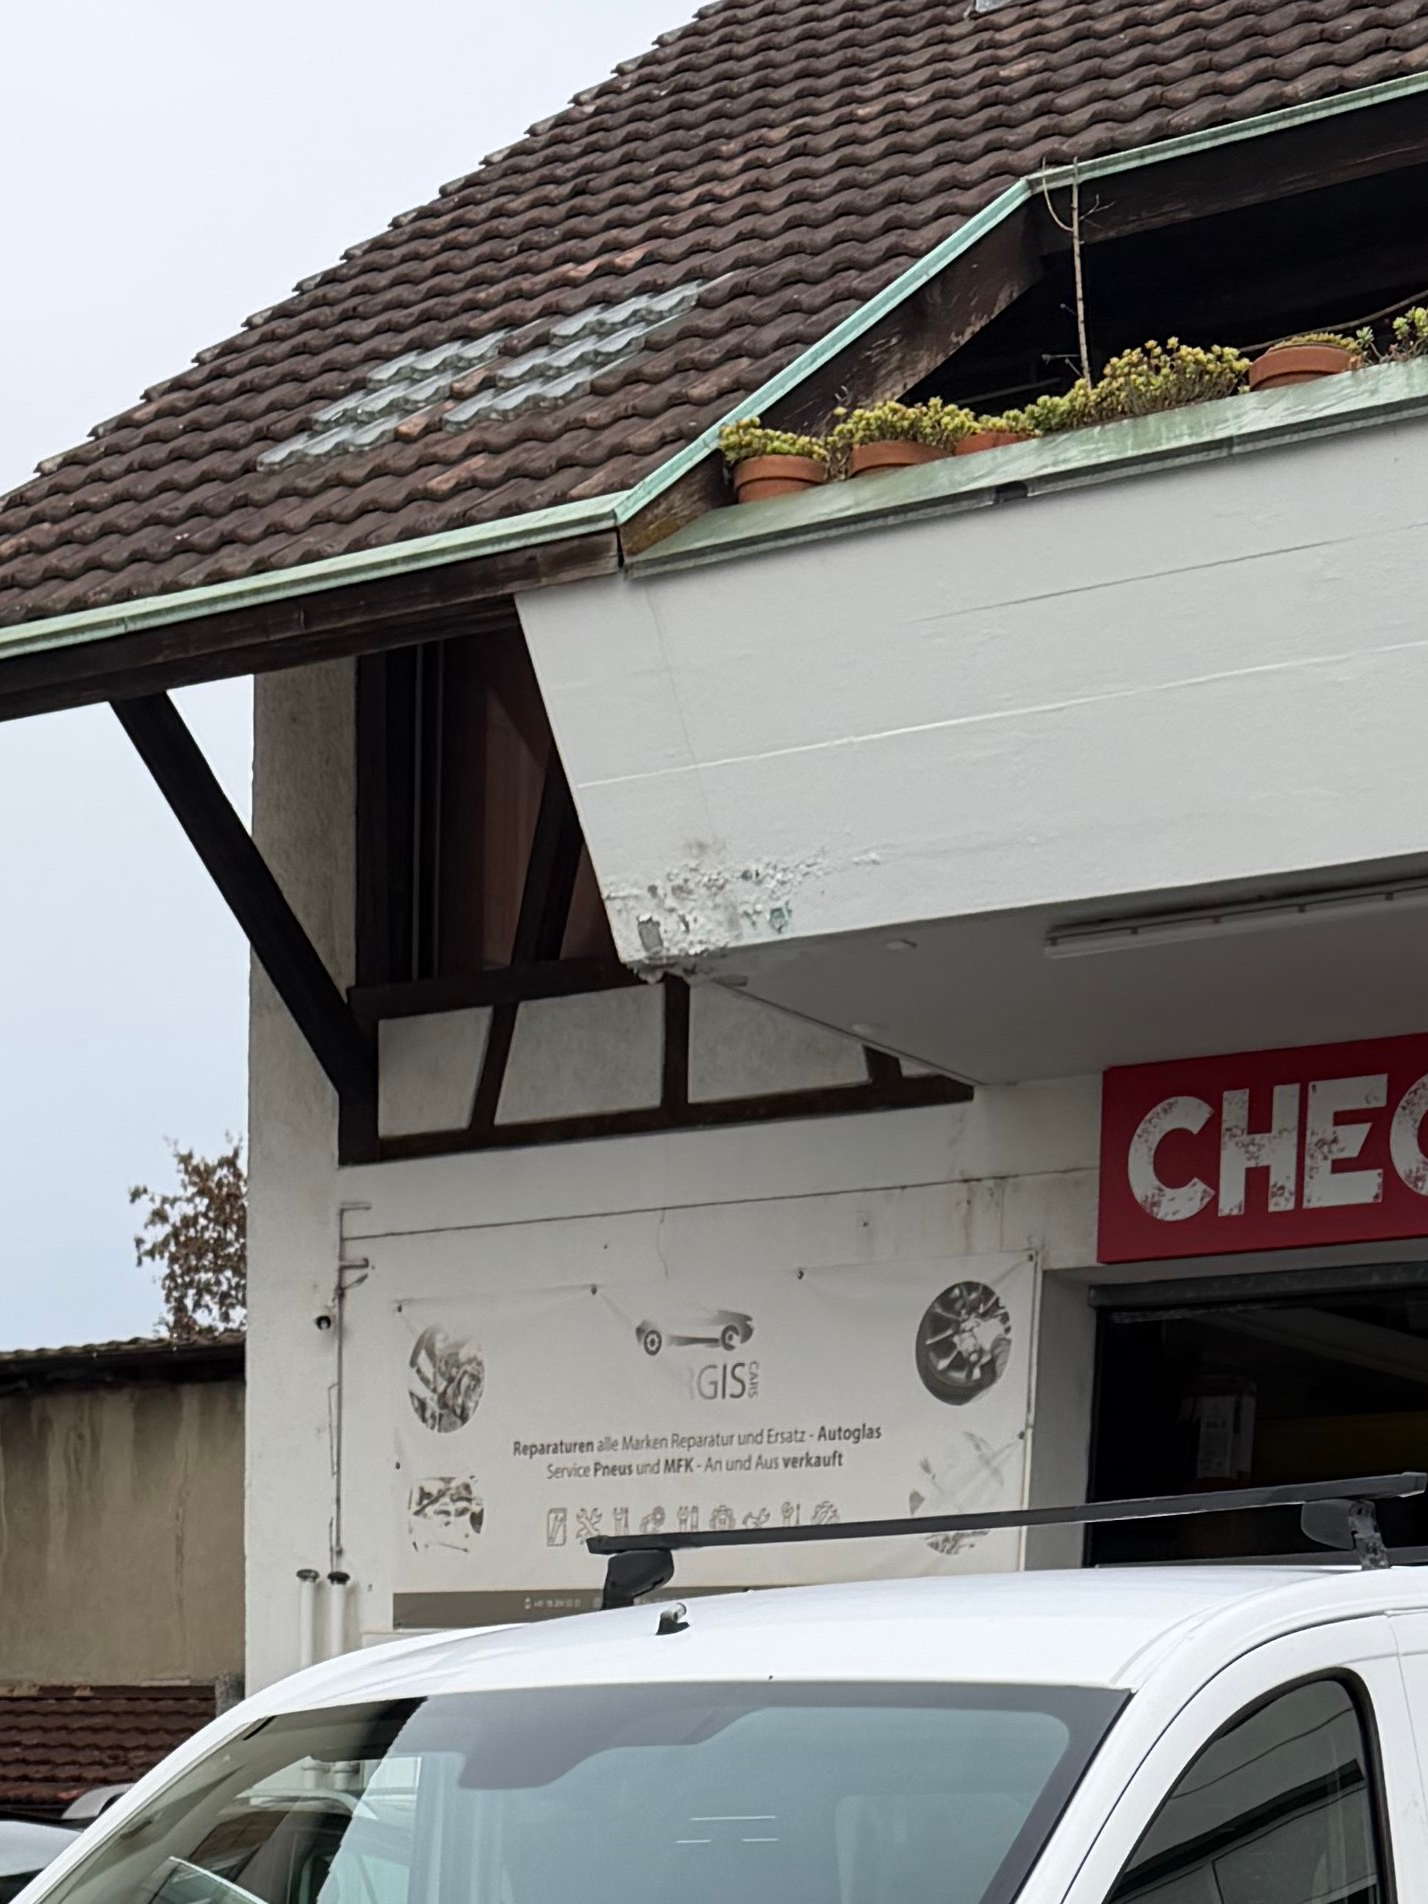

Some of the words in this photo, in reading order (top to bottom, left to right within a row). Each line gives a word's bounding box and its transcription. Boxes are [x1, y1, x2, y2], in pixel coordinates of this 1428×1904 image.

[694, 1362, 746, 1400] GIS
[513, 1440, 594, 1459] Reparaturen
[597, 1436, 619, 1452] alle
[622, 1434, 668, 1451] Marken
[671, 1431, 734, 1452] Reparatur
[738, 1429, 764, 1446] und
[767, 1428, 807, 1445] Ersatz
[817, 1423, 882, 1444] Autoglas
[546, 1463, 591, 1479] Service
[593, 1461, 633, 1477] Pneus
[636, 1459, 661, 1475] und
[664, 1457, 694, 1473] MFK
[704, 1456, 722, 1472] An
[725, 1455, 752, 1472] und
[755, 1453, 779, 1470] Aus
[782, 1451, 843, 1469] verkauft
